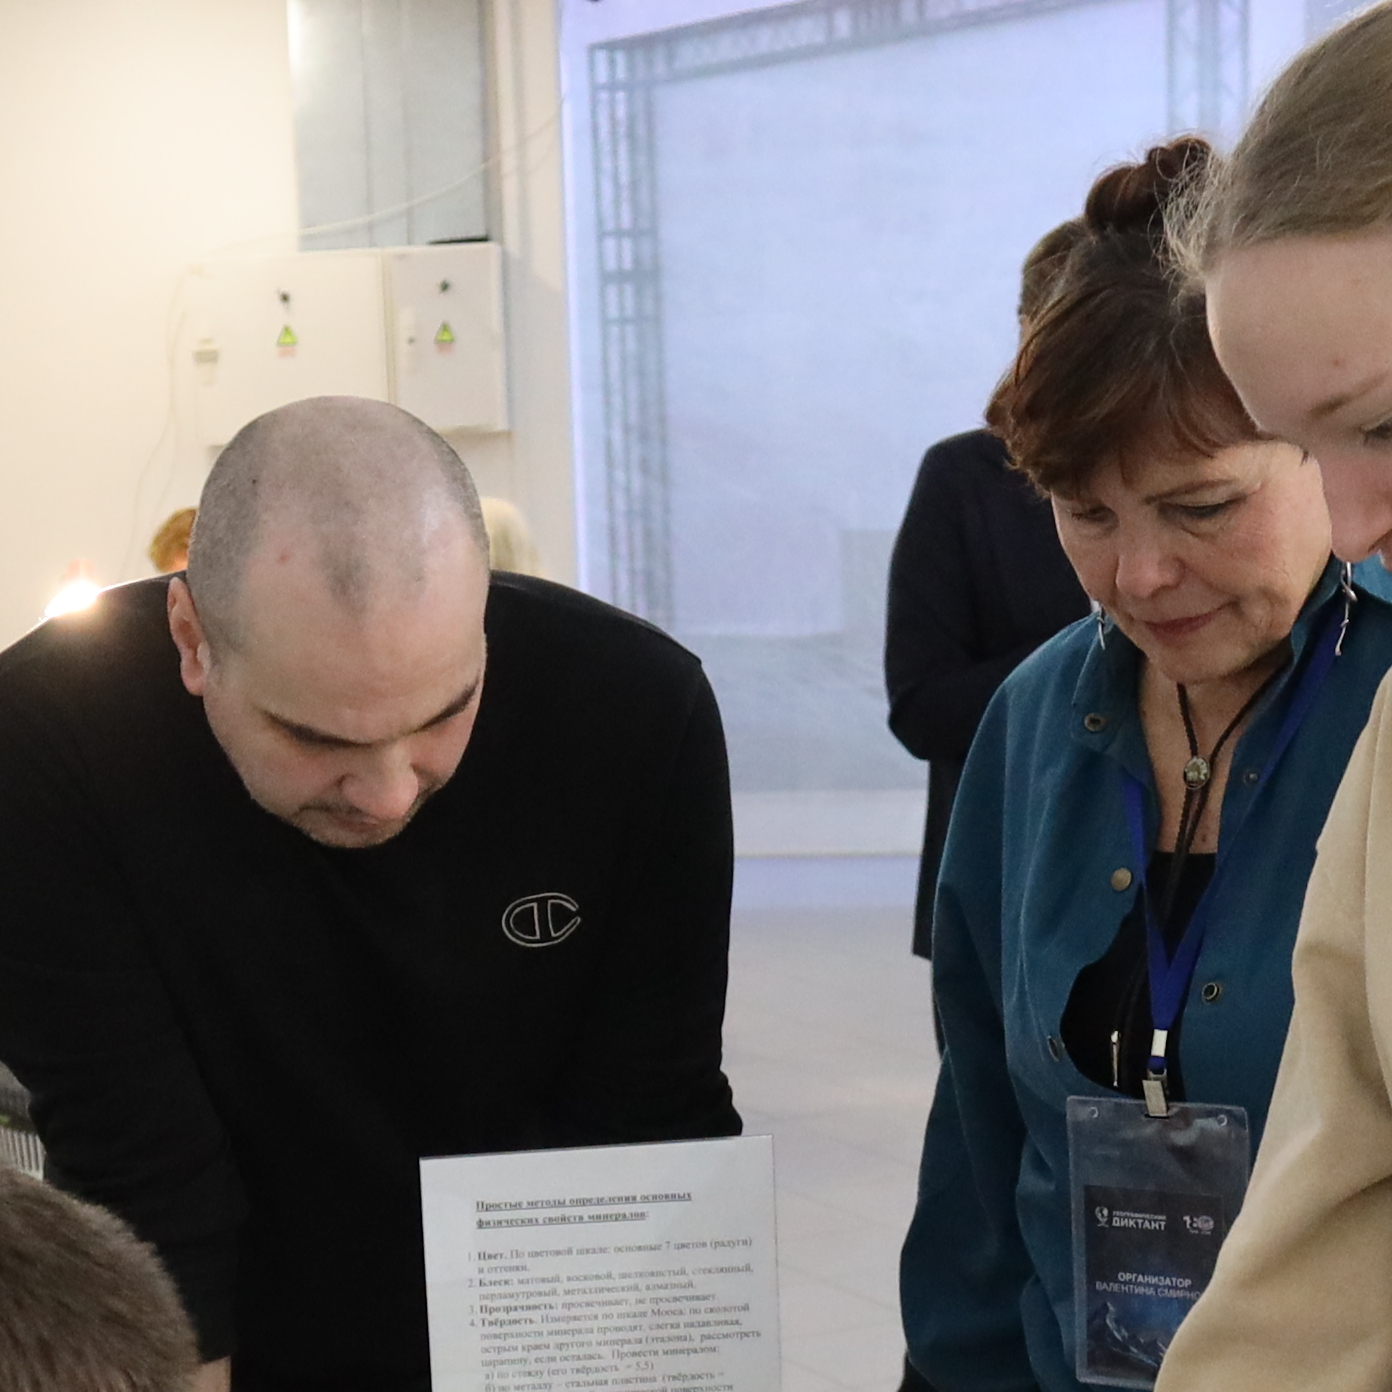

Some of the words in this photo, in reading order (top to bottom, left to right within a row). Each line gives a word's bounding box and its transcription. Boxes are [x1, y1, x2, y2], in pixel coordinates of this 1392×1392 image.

[474, 1199, 523, 1213] Простые
[526, 1198, 566, 1210] методы
[568, 1194, 637, 1208] определения
[639, 1191, 692, 1202] основных
[474, 1216, 539, 1230] физических
[541, 1212, 584, 1224] свойств
[1111, 1217, 1167, 1231] ДИКТАНТ
[1117, 1272, 1192, 1288] ОРГАНИЗАТОР
[1095, 1281, 1156, 1296] ВАЛЕНТИНА
[1157, 1287, 1202, 1301] СМИРНО
